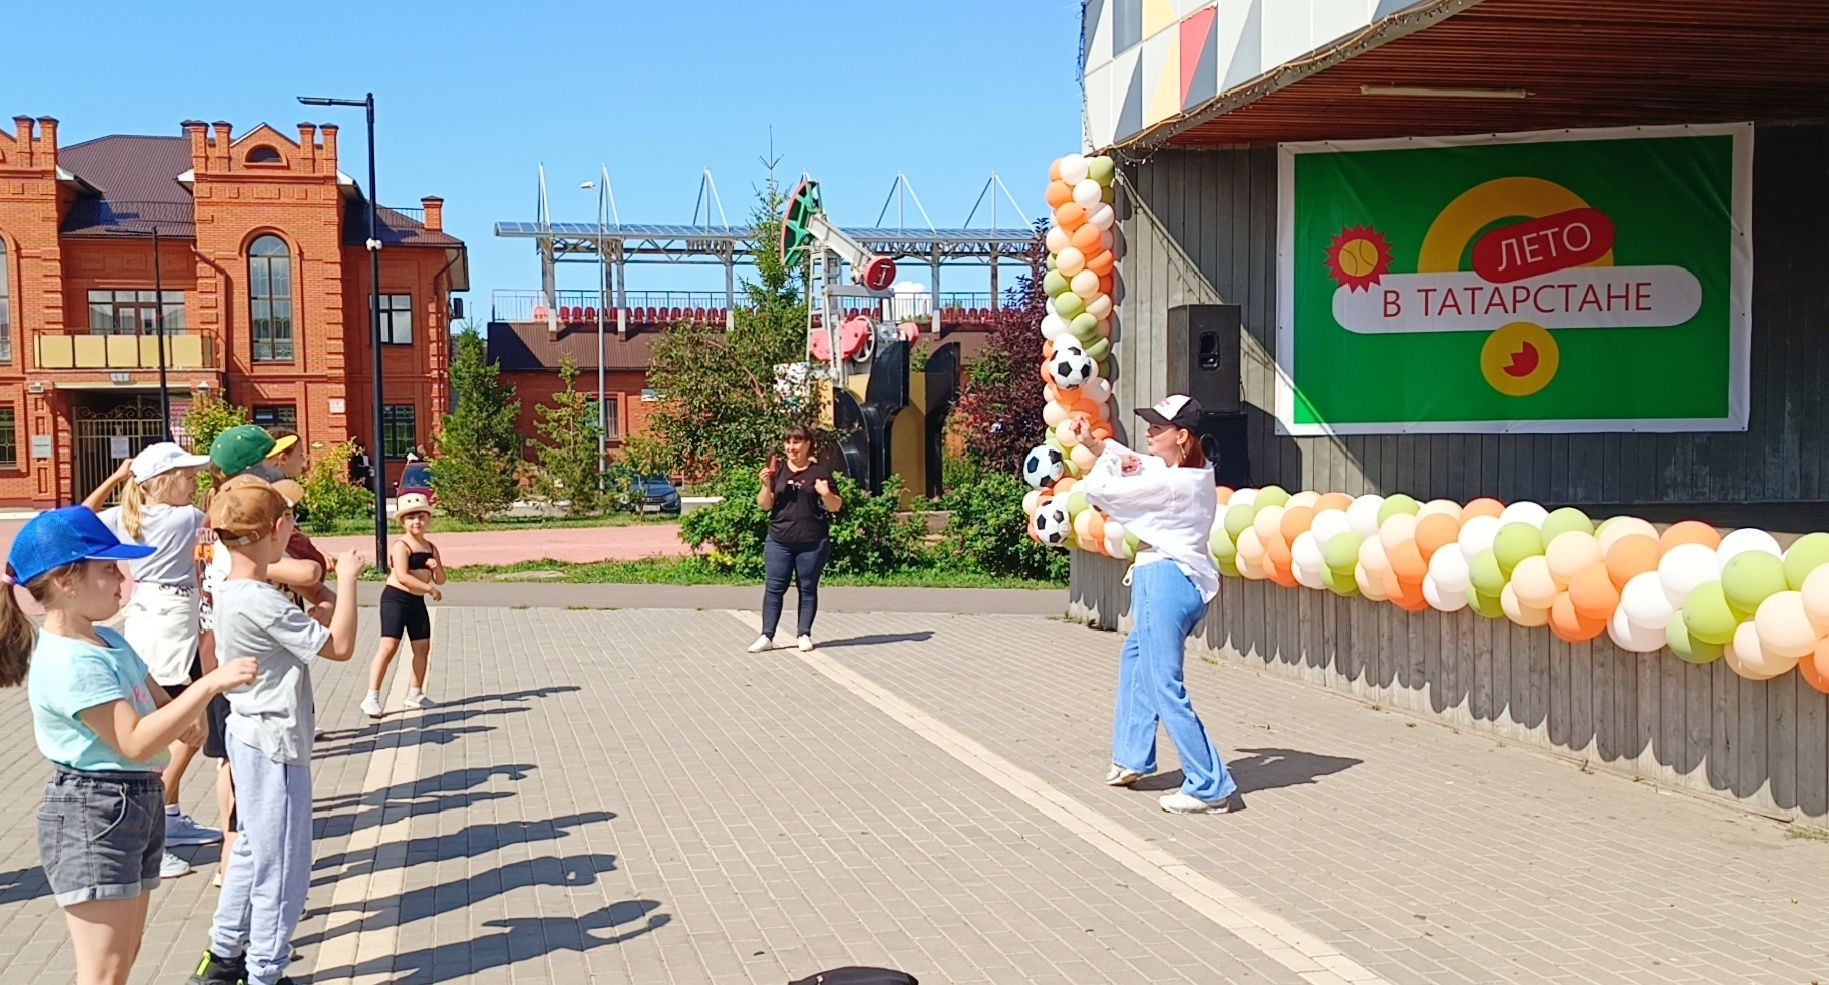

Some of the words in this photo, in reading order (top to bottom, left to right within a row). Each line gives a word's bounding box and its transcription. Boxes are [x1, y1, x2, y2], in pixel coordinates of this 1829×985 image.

[1498, 222, 1590, 271] ЛЕТО
[1383, 290, 1401, 317] В
[1417, 282, 1652, 316] ТАТАРСТАНЕ
